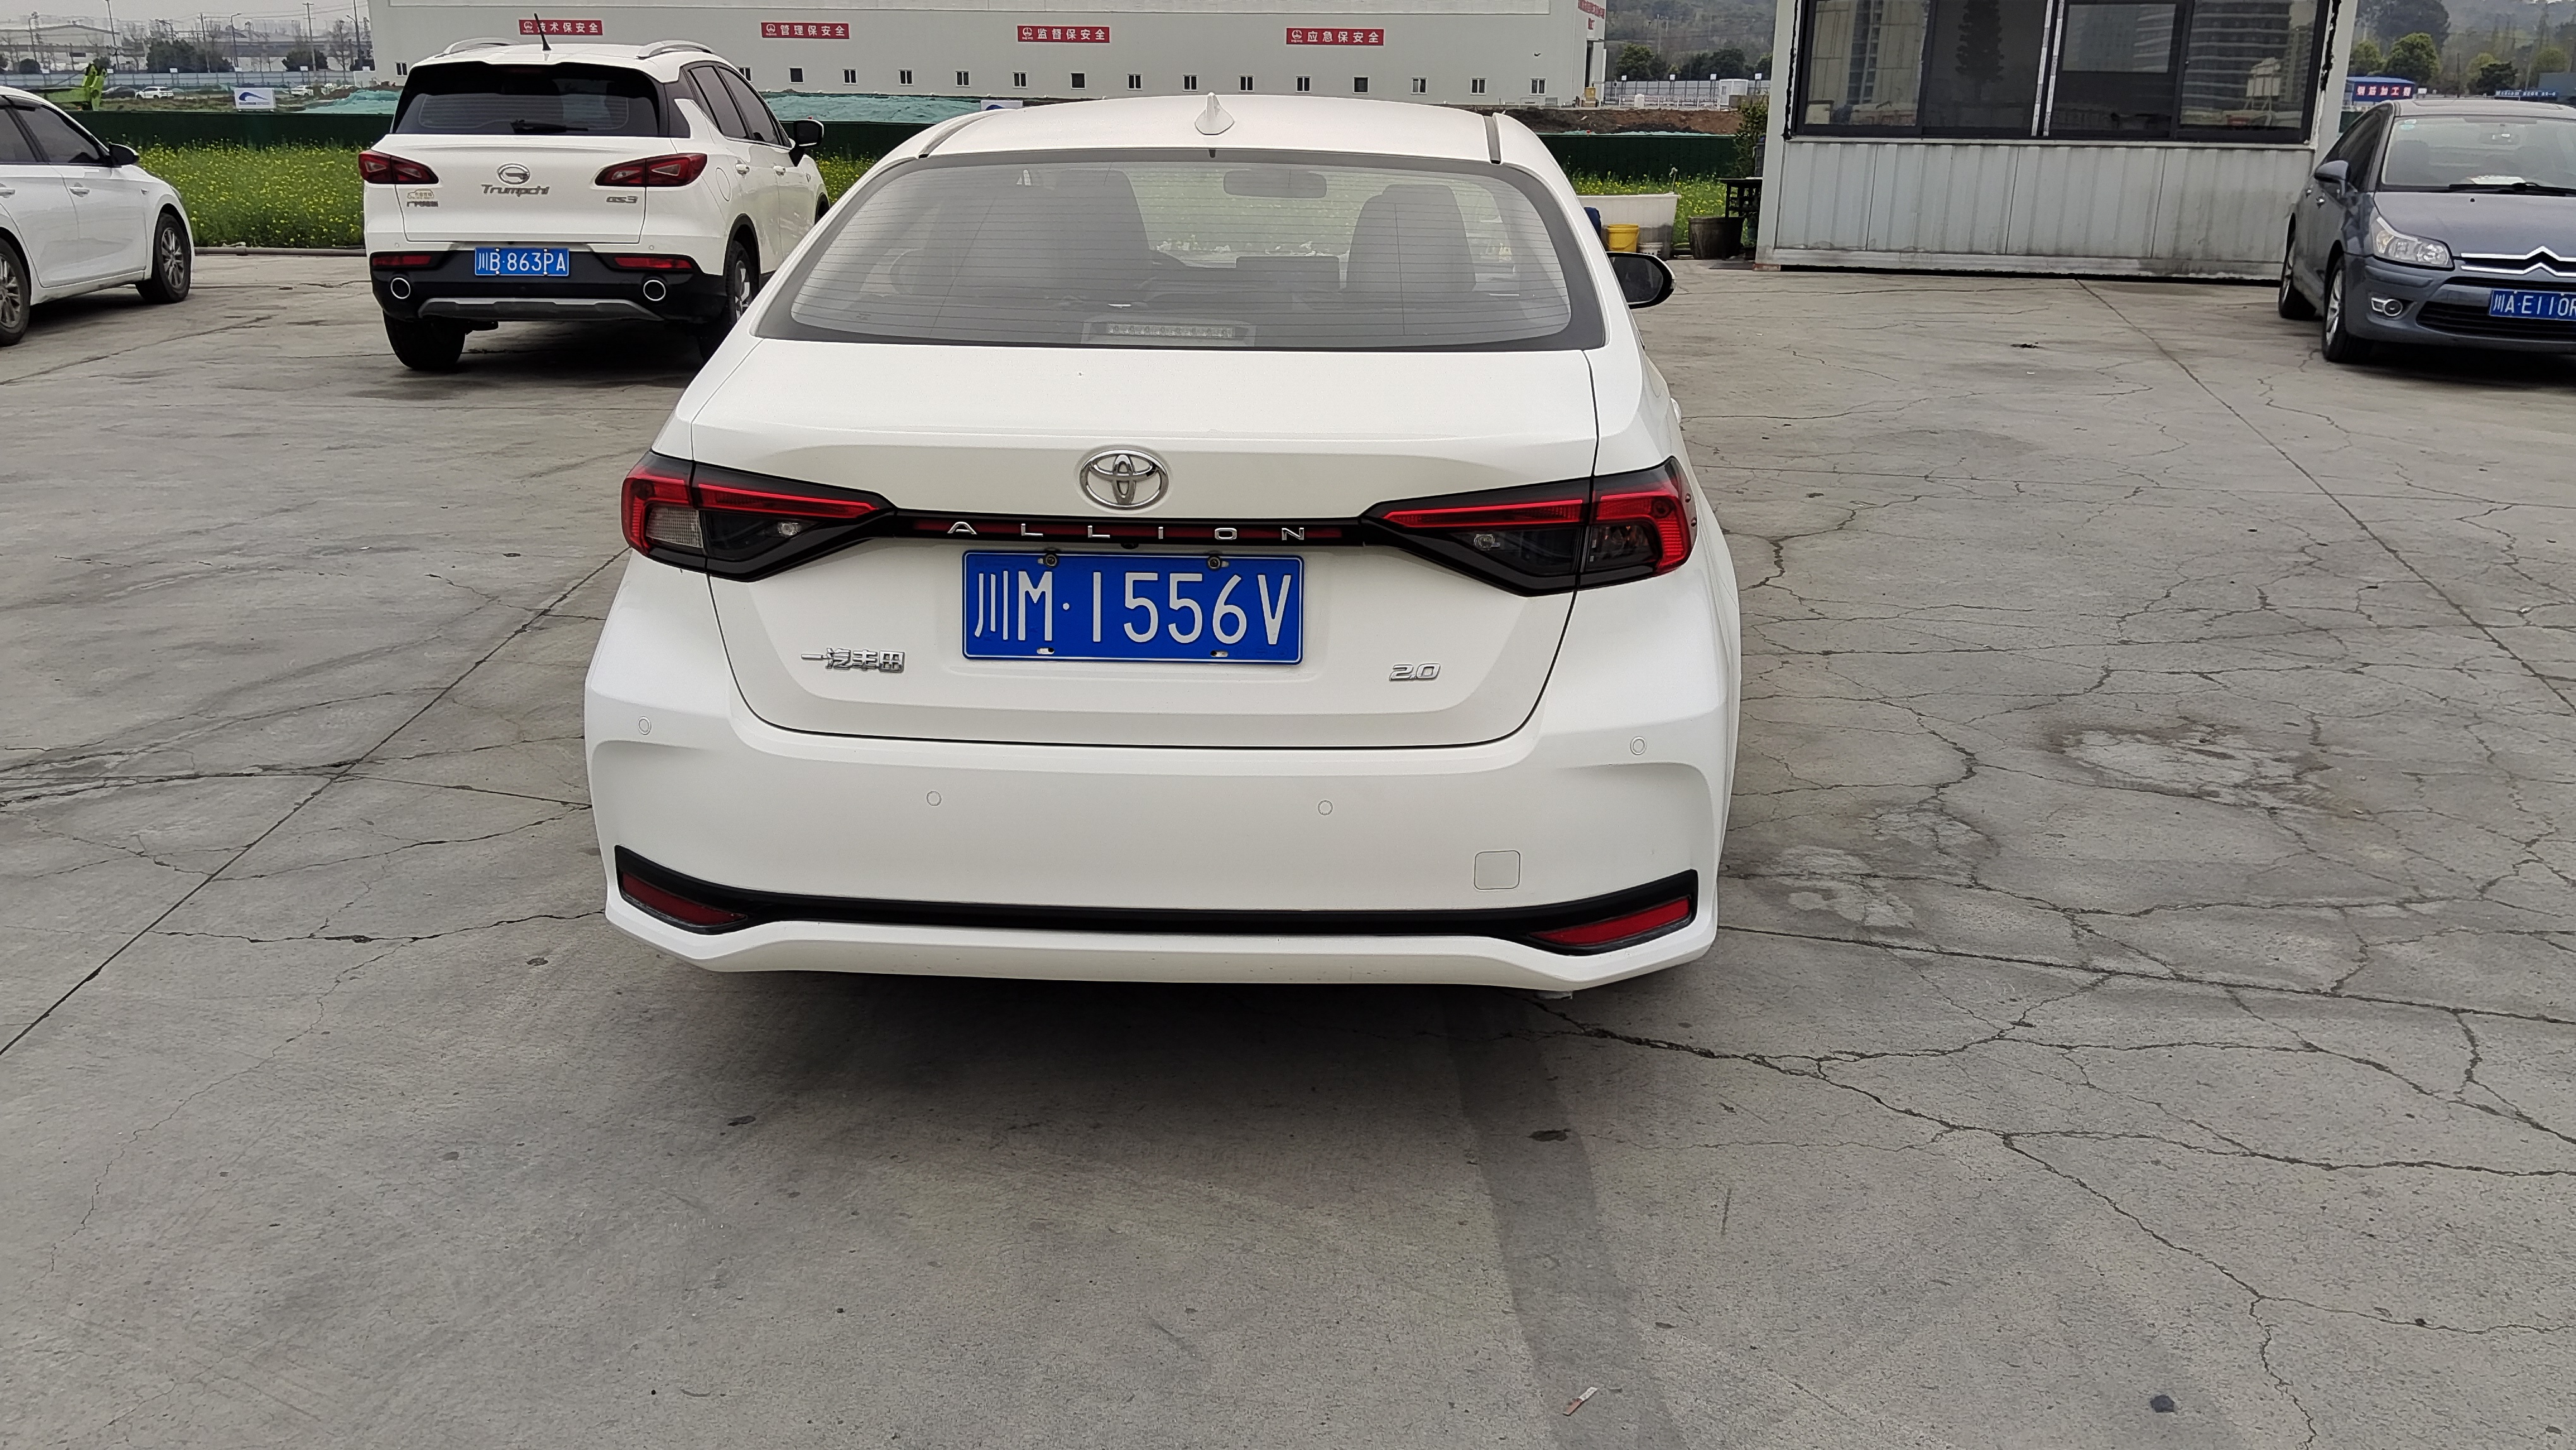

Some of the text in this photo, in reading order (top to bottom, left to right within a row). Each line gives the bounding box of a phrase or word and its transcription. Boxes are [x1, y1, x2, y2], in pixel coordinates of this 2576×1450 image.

[780, 25, 845, 37] 管理保安全
[1037, 28, 1105, 40] 监督保安全
[1307, 30, 1379, 43] 应急保安全
[481, 184, 550, 197] Trumpchi
[606, 195, 638, 204] GS3
[947, 521, 1305, 541] ALLION
[801, 647, 905, 674] 一汽丰田
[1389, 663, 1441, 681] 2.0
